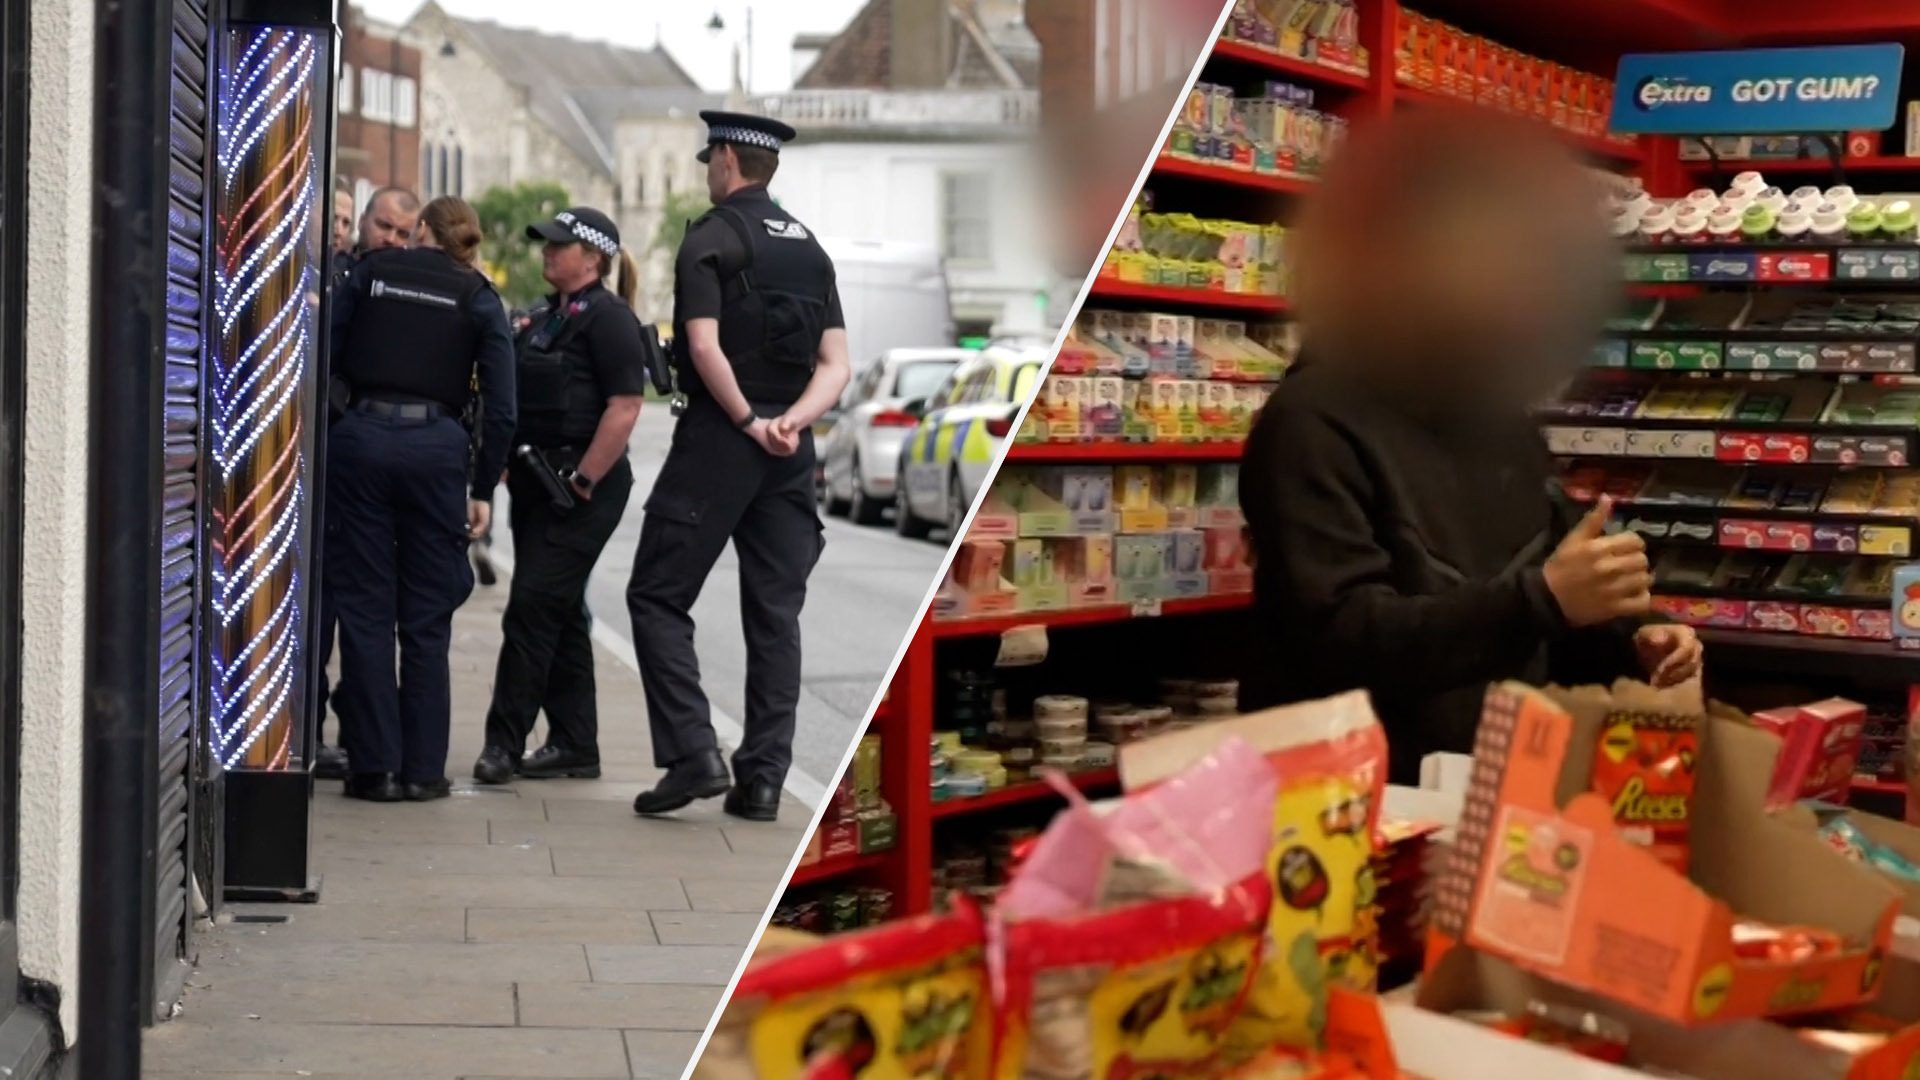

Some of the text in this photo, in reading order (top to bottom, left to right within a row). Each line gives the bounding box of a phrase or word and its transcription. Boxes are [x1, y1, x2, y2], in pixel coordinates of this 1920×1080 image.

[1640, 75, 1880, 105] extra GOT GUM?
